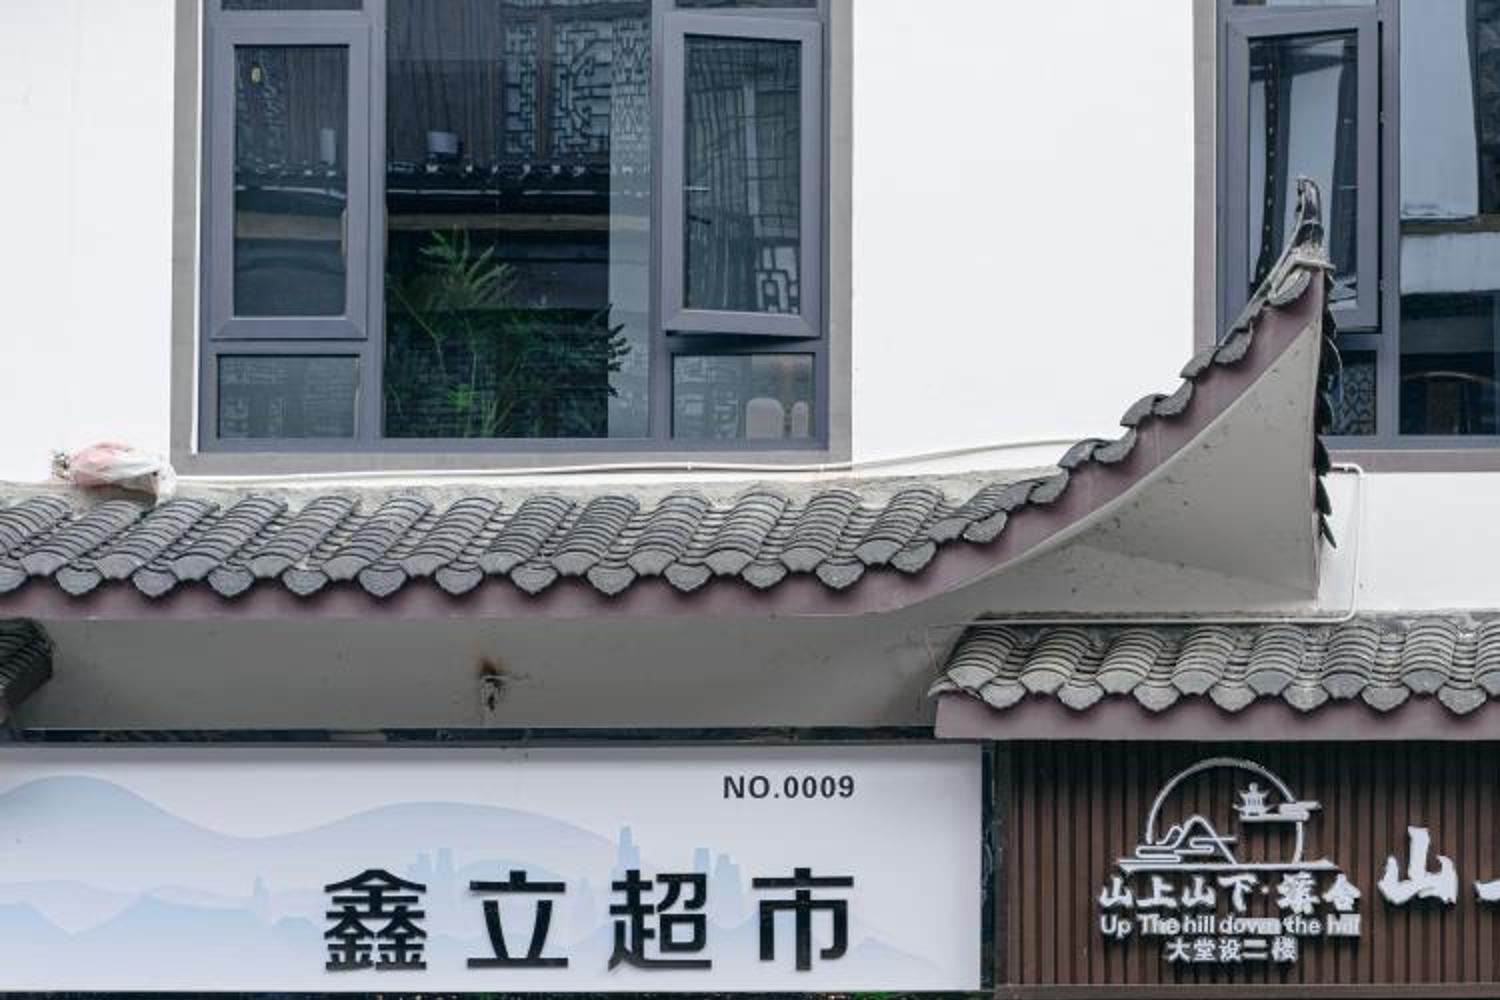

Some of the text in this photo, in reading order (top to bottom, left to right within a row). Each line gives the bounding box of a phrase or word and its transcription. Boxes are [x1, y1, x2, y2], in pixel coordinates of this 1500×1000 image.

[721, 774, 857, 800] NO.0009
[323, 866, 855, 972] 鑫立超市
[1100, 913, 1361, 939] Up The hill down the hill
[1167, 937, 1299, 963] 大堂设二楼
